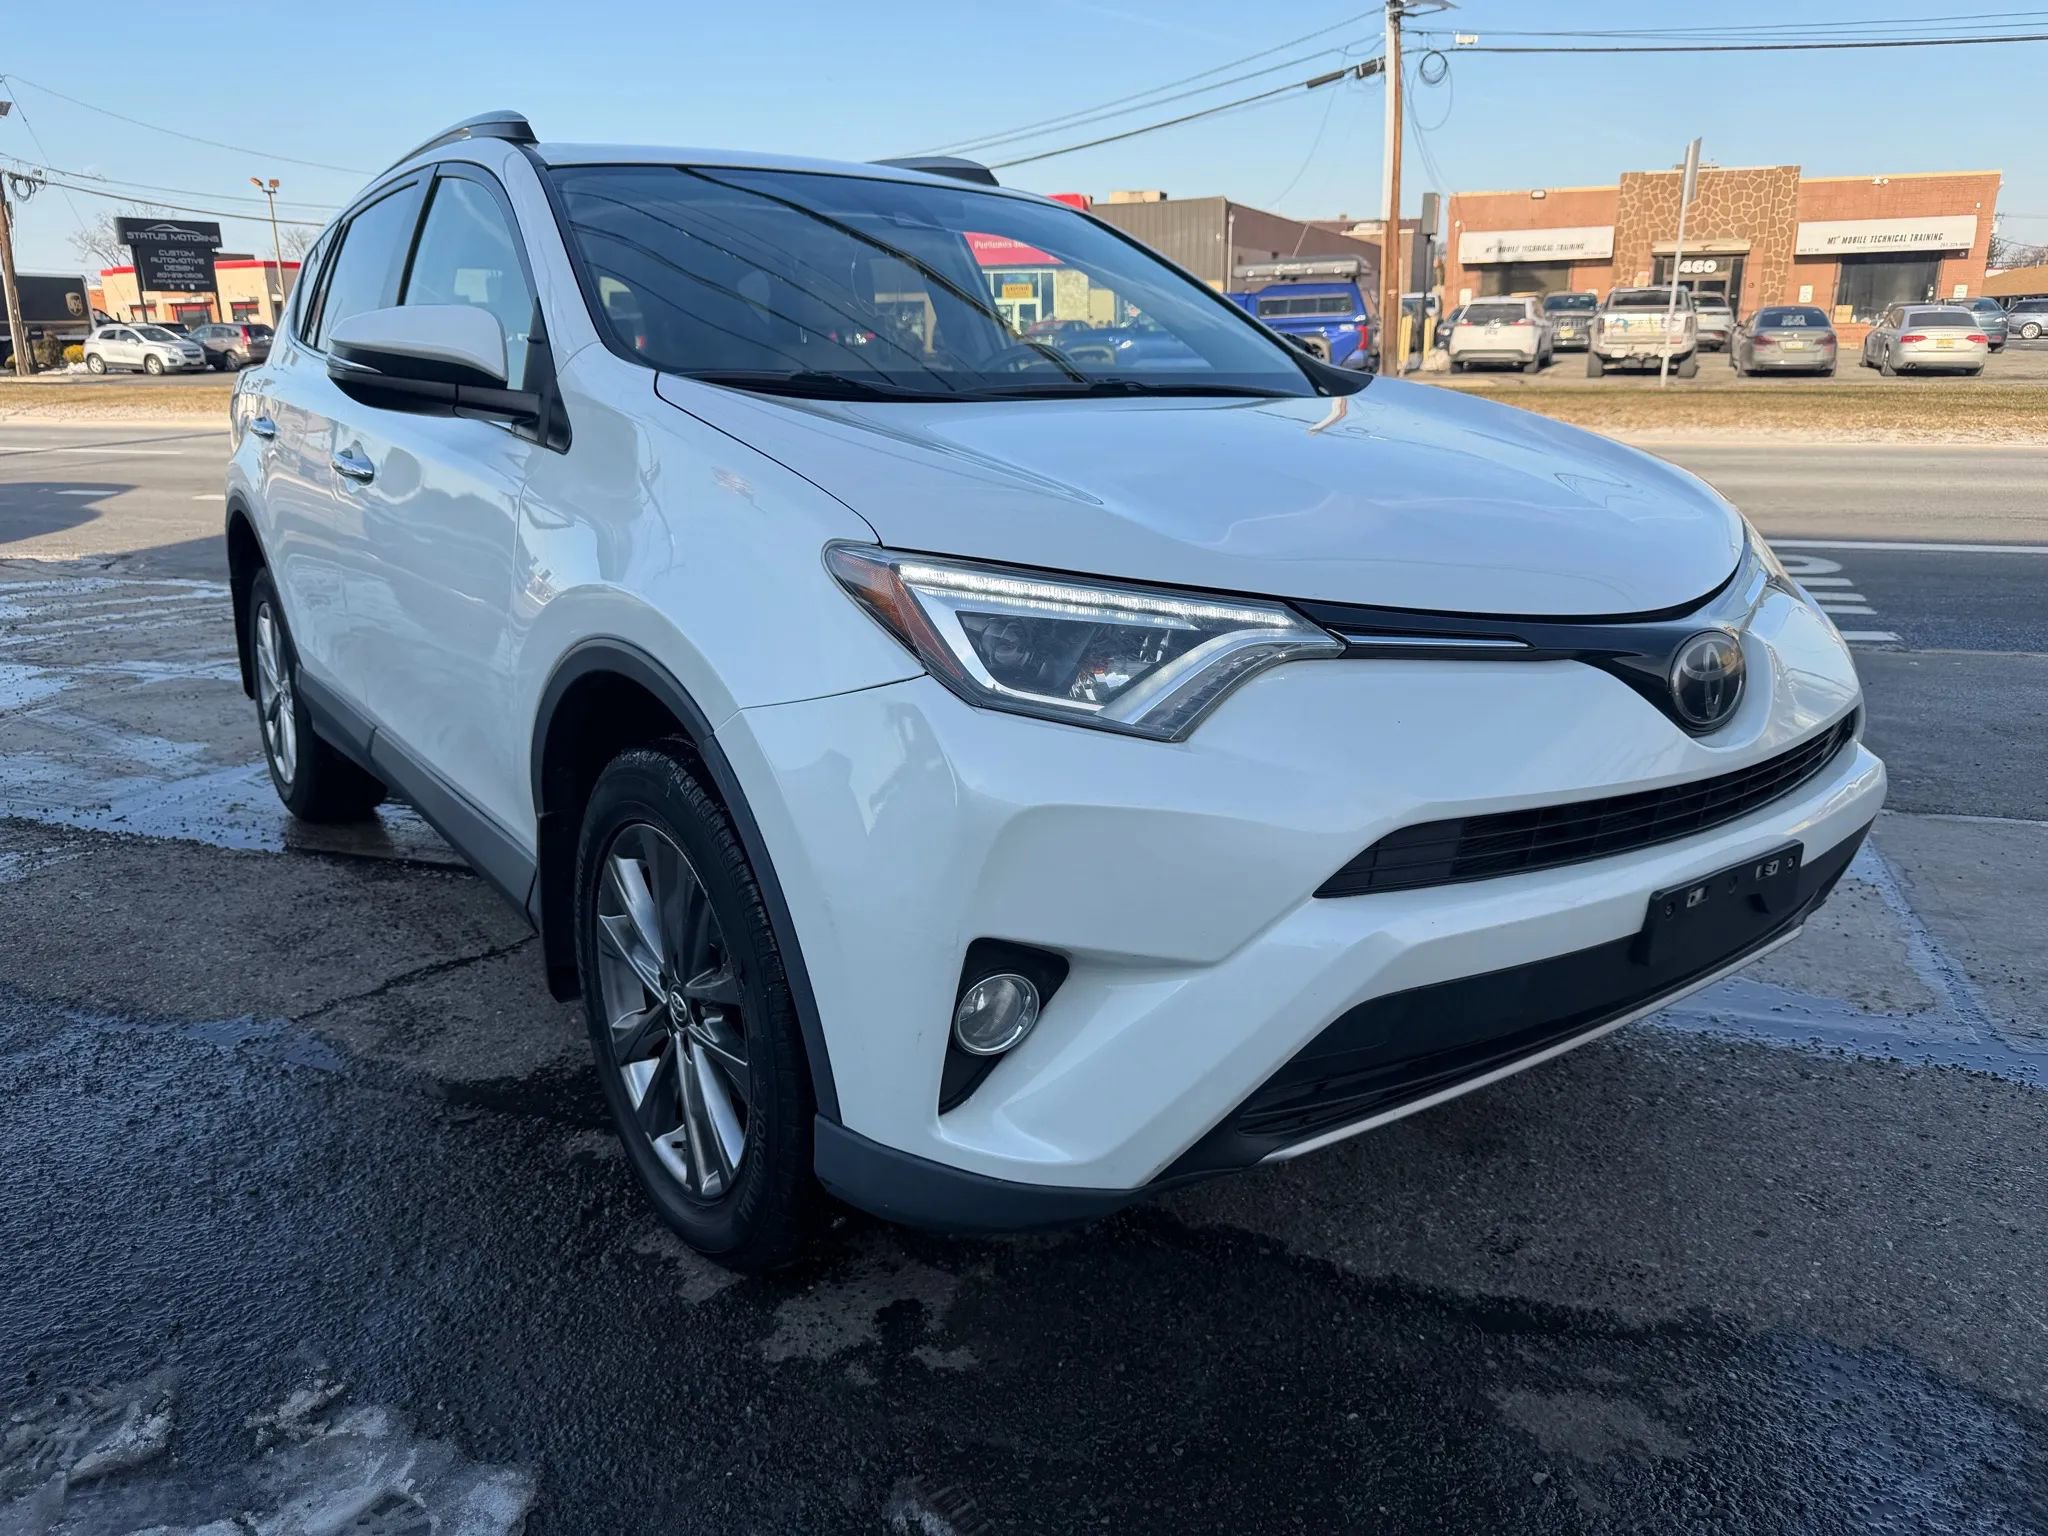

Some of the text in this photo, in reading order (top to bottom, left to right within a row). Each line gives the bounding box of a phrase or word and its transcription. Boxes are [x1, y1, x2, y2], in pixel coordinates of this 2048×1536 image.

[127, 231, 220, 244] STATUS MOTORING
[1842, 235, 1867, 245] MOBILE
[1870, 233, 1907, 244] TECHNICAL
[1910, 232, 1944, 243] TRAINING
[158, 249, 195, 257] CUSTOM
[150, 256, 205, 265] AUTOMOTIVE
[164, 264, 194, 272] DESIGN
[1679, 259, 1717, 274] 460
